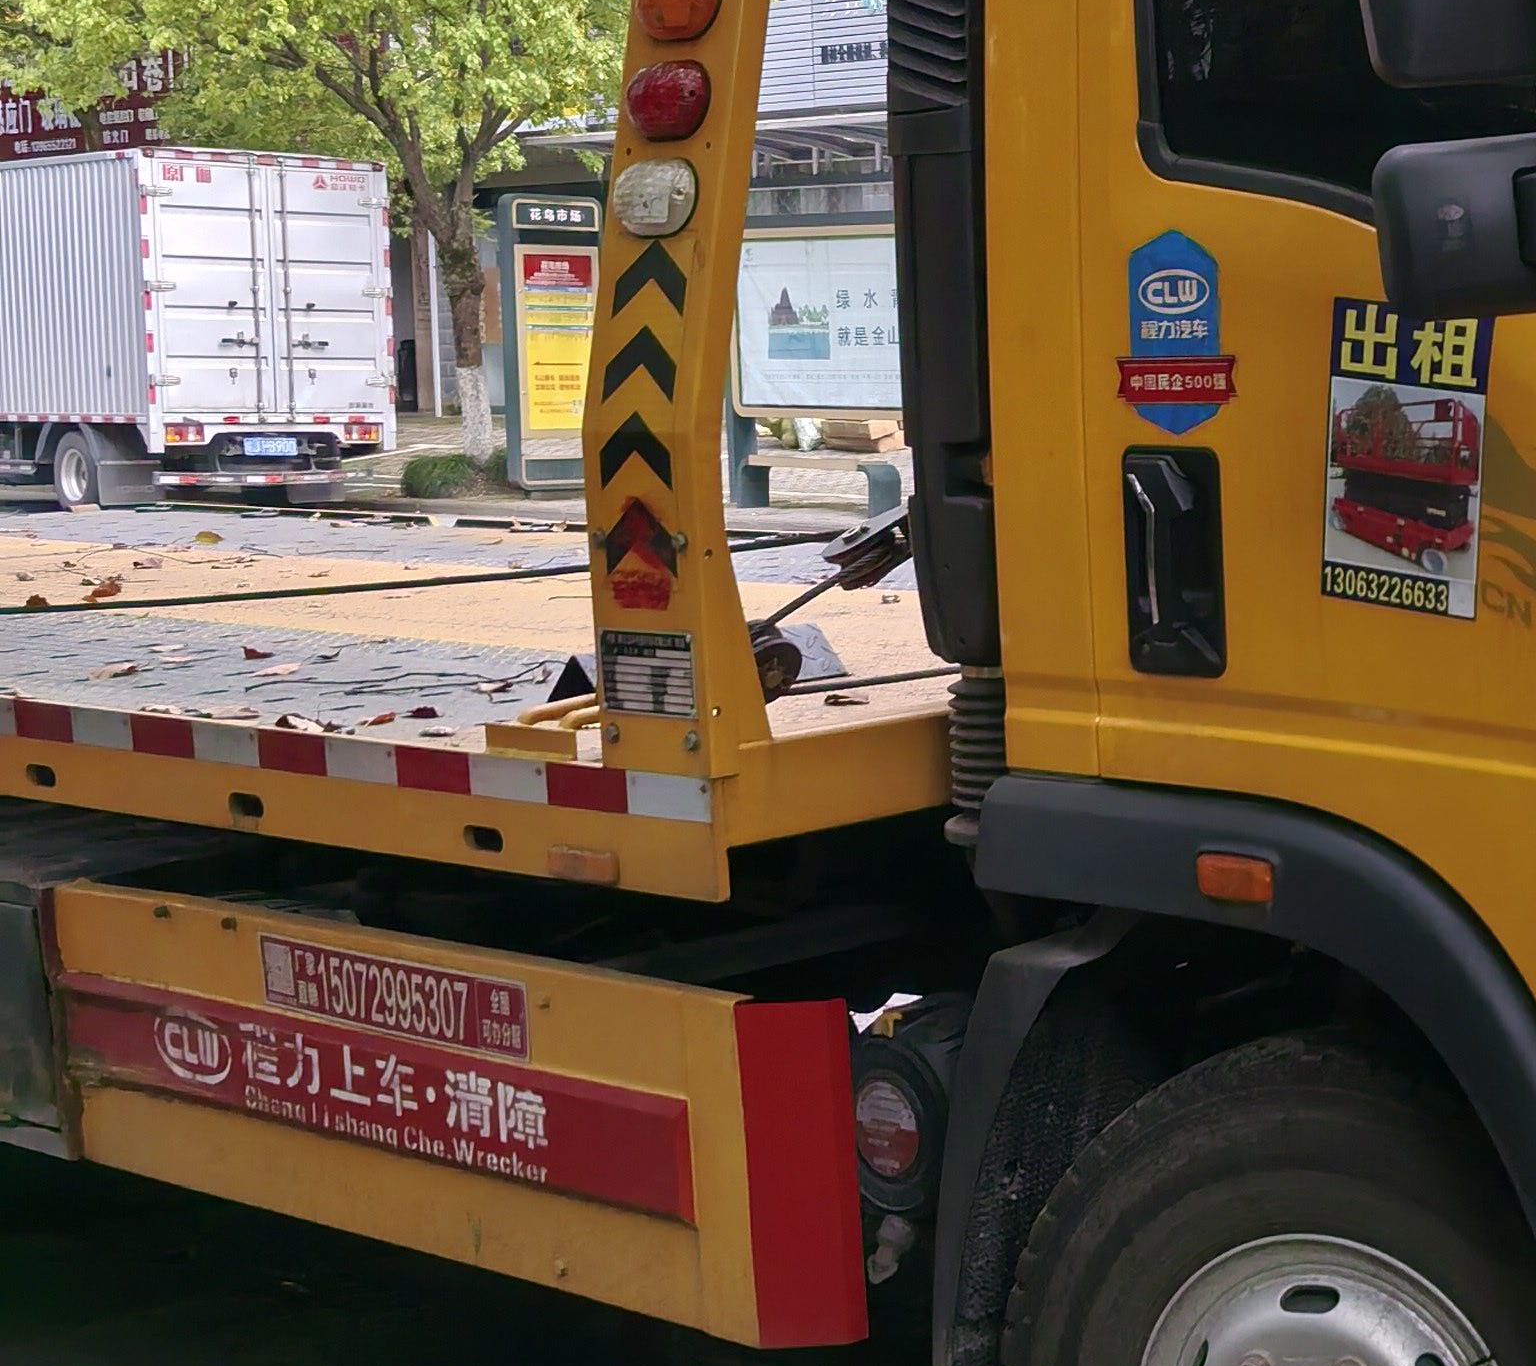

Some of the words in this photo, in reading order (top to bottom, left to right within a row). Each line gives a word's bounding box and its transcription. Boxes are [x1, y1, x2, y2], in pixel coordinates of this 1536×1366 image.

[528, 207, 582, 223] 花鸟市场
[1146, 279, 1198, 305] CLW
[1140, 319, 1209, 340] 程力汽车
[1339, 304, 1479, 387] 出租
[1130, 372, 1227, 392] 中国民企500强
[1323, 565, 1448, 612] 13063226633
[317, 953, 468, 1042] 15072995307
[164, 1021, 219, 1069] CLW
